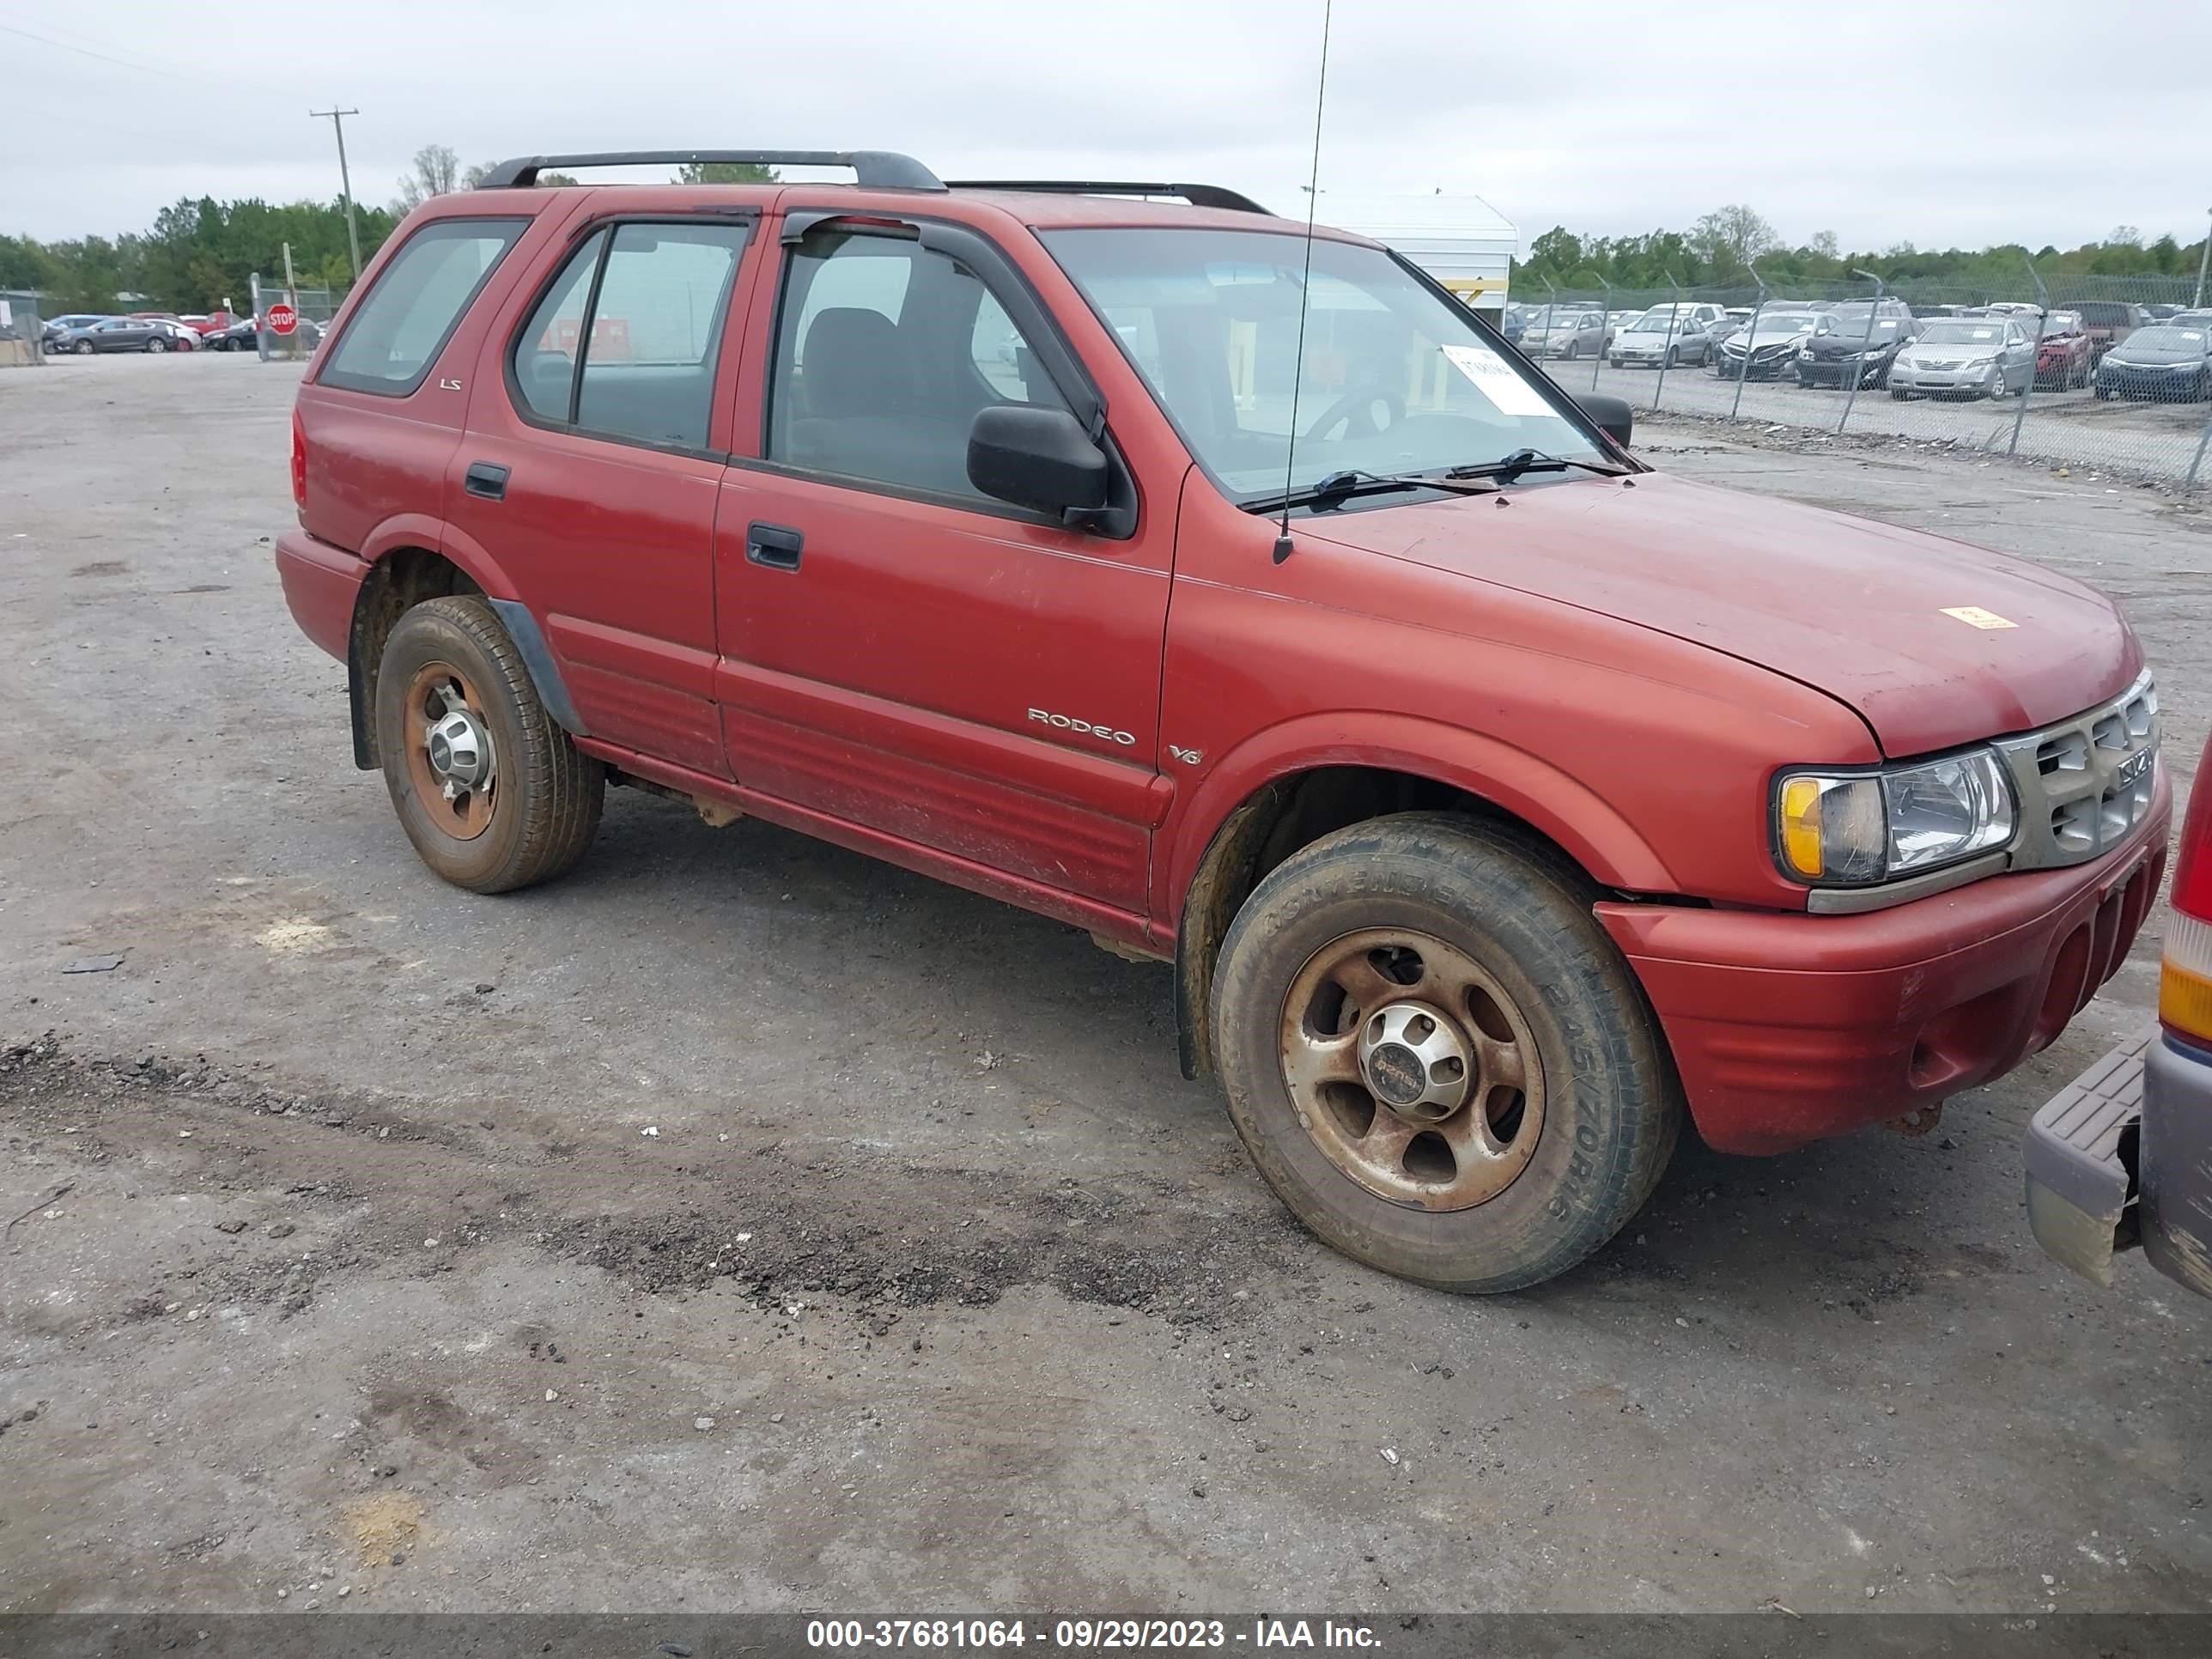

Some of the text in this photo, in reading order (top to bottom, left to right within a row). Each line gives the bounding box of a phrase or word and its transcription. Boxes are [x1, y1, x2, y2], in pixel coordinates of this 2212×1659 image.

[270, 313, 295, 326] STOP
[440, 378, 462, 391] LS
[1028, 708, 1136, 746] RODEO
[1170, 744, 1202, 765] V6
[1540, 982, 1602, 1222] 245/70R16
